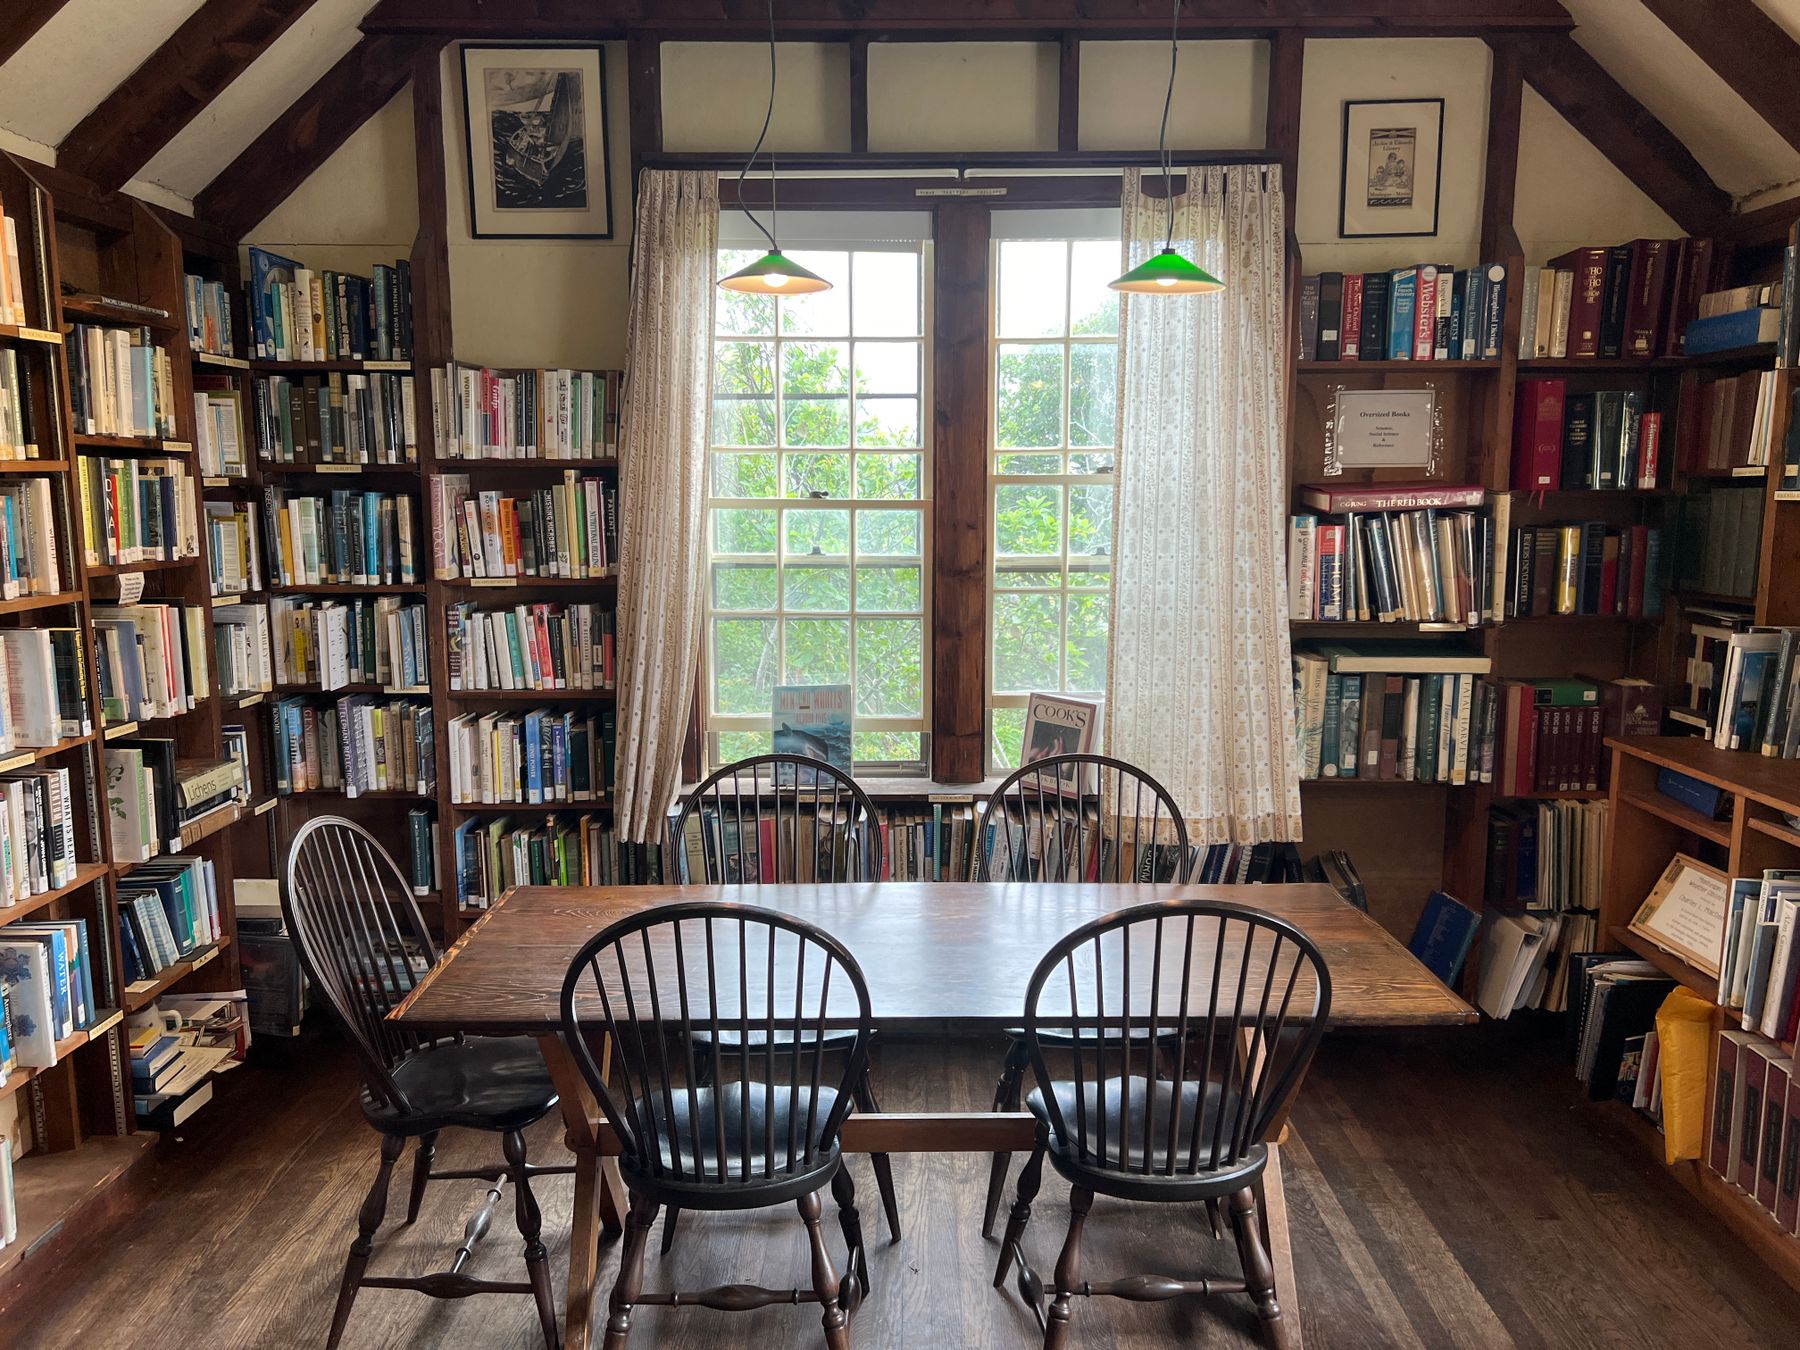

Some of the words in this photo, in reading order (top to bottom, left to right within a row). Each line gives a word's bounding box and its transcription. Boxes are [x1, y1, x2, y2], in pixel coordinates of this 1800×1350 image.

[1352, 306, 1360, 330] Oxford
[1419, 281, 1434, 338] Webster's
[1490, 283, 1500, 321] Biographical
[264, 487, 273, 515] INSECTS
[1416, 498, 1442, 506] BOOK
[433, 525, 444, 558] YOGA
[1462, 681, 1471, 711] FATAL
[1034, 704, 1086, 728] COOK'S
[1428, 697, 1437, 731] SIERRA
[1426, 736, 1434, 760] CLUB
[1459, 716, 1470, 764] HARVEST
[343, 746, 352, 786] REFLECTIONS
[51, 777, 62, 821] QUANTUM
[188, 780, 216, 800] Lichens
[58, 952, 66, 994] WATER
[4, 997, 12, 1040] Atmosphere
